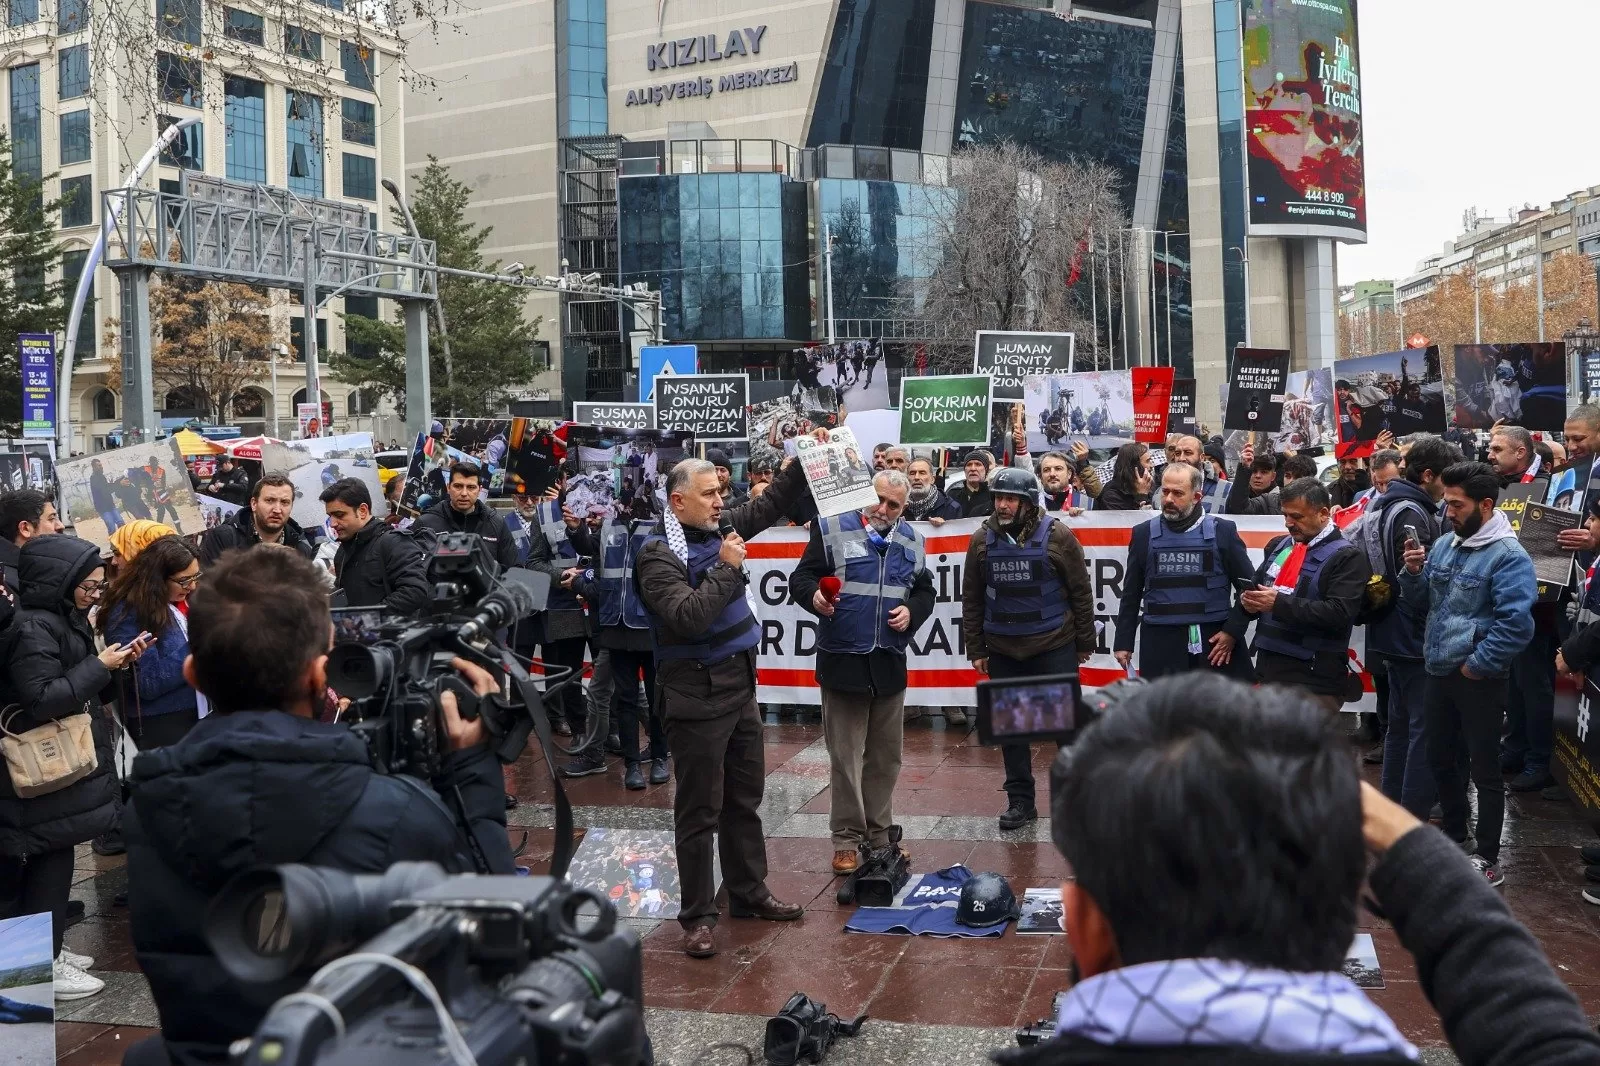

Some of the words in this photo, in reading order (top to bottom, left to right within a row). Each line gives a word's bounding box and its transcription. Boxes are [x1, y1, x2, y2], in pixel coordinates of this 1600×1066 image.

[647, 25, 767, 71] KIZILAY
[1335, 36, 1350, 60] En
[625, 76, 714, 107] ALIŞVERİŞ
[718, 61, 799, 93] MERKEZİ
[1322, 82, 1360, 115] Tercihi
[1305, 190, 1322, 202] 444
[1323, 190, 1330, 203] 8
[1330, 191, 1344, 204] 909
[996, 343, 1053, 354] HUMAN
[994, 355, 1053, 365] DIGNITY
[978, 365, 1012, 376] WILL
[663, 381, 738, 395] İNSANLIK
[672, 396, 730, 408] ONURU
[905, 395, 987, 409] SOYKIRIMI
[592, 408, 647, 419] SUSMA
[659, 405, 744, 421] SİYONİZMİ
[911, 410, 977, 424] DURDUR
[662, 422, 740, 434] YENECEK
[797, 434, 840, 450] Gae
[1158, 552, 1200, 563] BASIN
[992, 560, 1030, 572] BASIN
[1158, 564, 1200, 573] PRESS
[993, 572, 1031, 582] PRESS
[973, 900, 986, 912] 25
